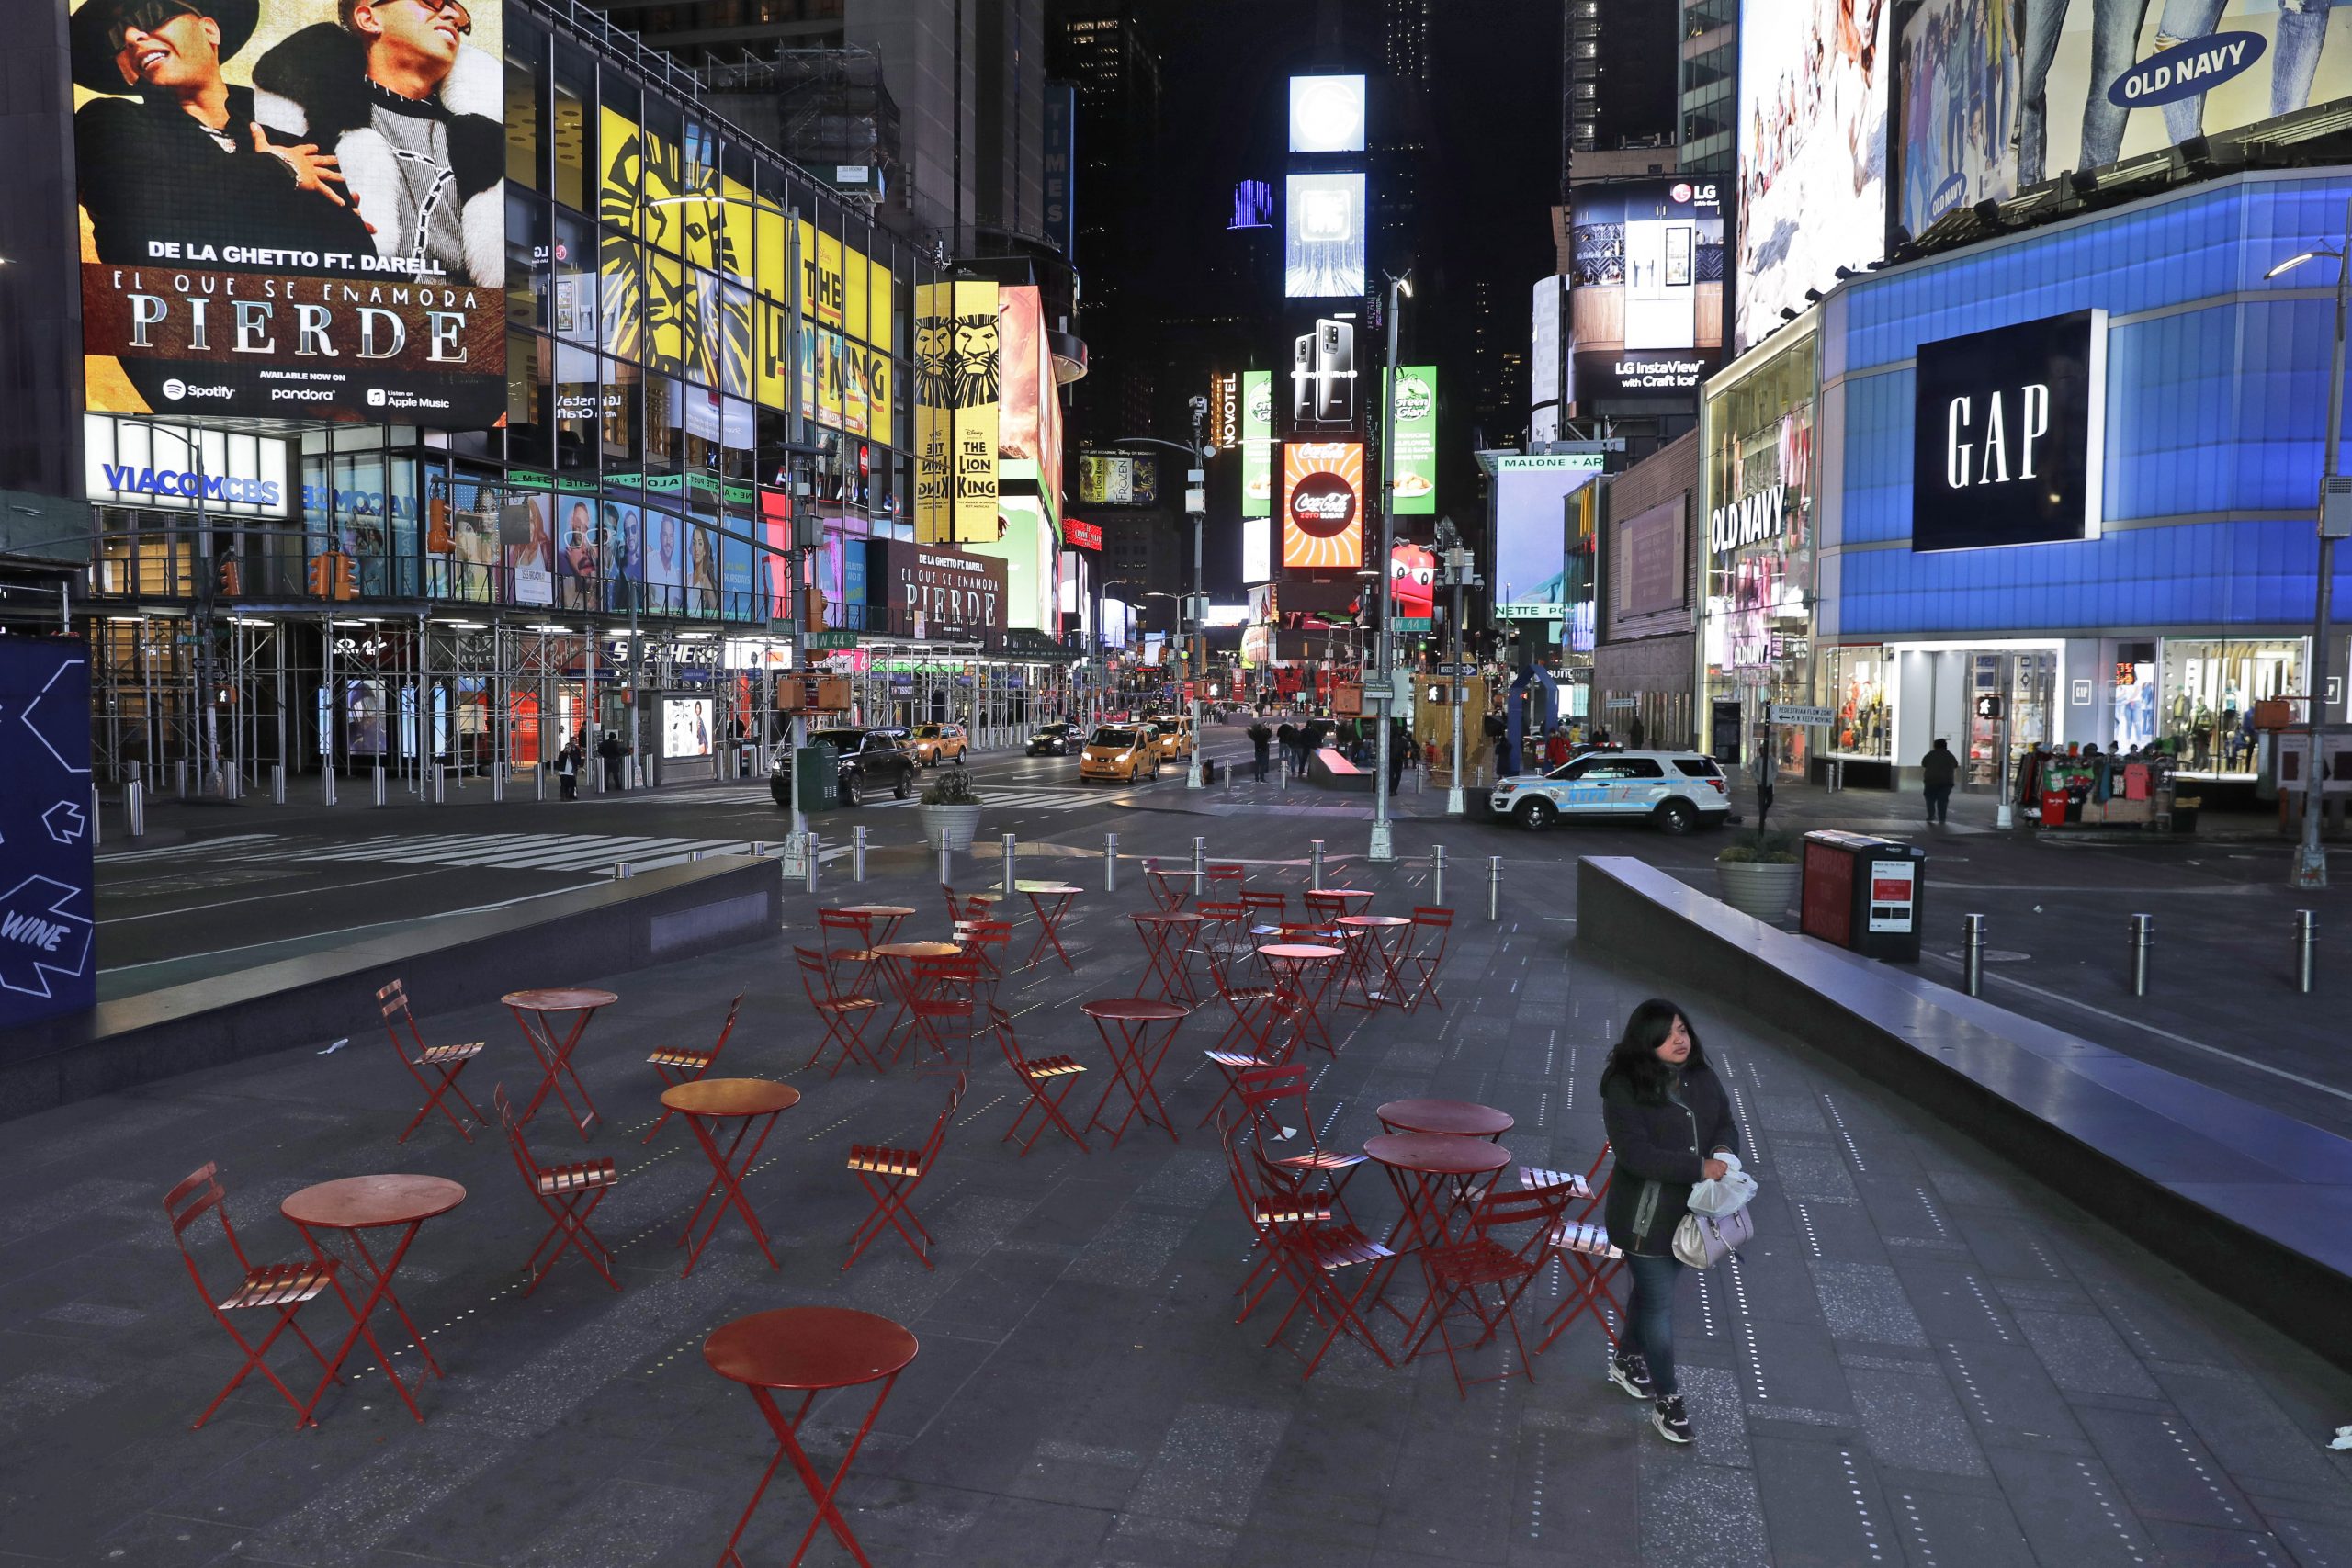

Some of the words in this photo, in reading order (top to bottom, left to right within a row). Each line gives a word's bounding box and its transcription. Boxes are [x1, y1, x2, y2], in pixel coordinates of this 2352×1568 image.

[2124, 66, 2171, 100] OLD
[2177, 39, 2246, 84] NAVY
[1694, 185, 1716, 199] LG
[1932, 194, 1945, 216] OLD
[1945, 178, 1963, 208] NAVY
[148, 241, 181, 259] DE
[187, 243, 218, 261] LA
[222, 245, 319, 268] GHETTO
[323, 253, 356, 270] FT.
[360, 254, 447, 276] DARELL
[114, 270, 143, 290] EL
[175, 274, 234, 295] QUE
[264, 279, 295, 299] SE
[323, 283, 477, 310] ENAMORA
[804, 259, 842, 309] THE
[127, 294, 468, 363] PIERDE
[260, 370, 308, 380] AVAILABLE
[310, 372, 329, 381] NOW
[331, 374, 345, 382] ON
[1615, 362, 1635, 375] LG
[1622, 378, 1642, 388] with
[1643, 375, 1675, 388] Craft
[1677, 375, 1696, 387] Ice
[188, 385, 234, 400] Spotify
[271, 389, 335, 401] pandora
[388, 397, 418, 408] Apple
[419, 398, 449, 409] Music
[1223, 372, 1236, 448] NOVOTEL
[1395, 398, 1429, 407] Green
[1396, 407, 1429, 417] Giant
[1947, 384, 2049, 489] GAP
[963, 442, 986, 453] THE
[959, 456, 991, 474] LION
[1504, 458, 1566, 467] MALONE
[103, 463, 280, 505] VIACOMCBS
[957, 476, 996, 498] KING
[1116, 460, 1129, 502] FROZEN
[1295, 492, 1351, 513] Coca-Cola
[1711, 502, 1739, 554] OLD
[1740, 483, 1787, 546] NAVY
[919, 554, 928, 565] DE
[927, 555, 935, 566] LA
[935, 556, 956, 569] GHETTO
[965, 560, 985, 573] DARELL
[724, 573, 751, 585] HURSDAYS
[901, 567, 911, 581] EL
[919, 570, 936, 584] QUE
[943, 572, 952, 586] SE
[905, 583, 996, 627] PIERDE
[1496, 606, 1539, 615] NETTE
[1396, 618, 1402, 628] W
[1407, 618, 1419, 629] 44
[819, 634, 828, 646] W
[832, 634, 845, 647] 44
[849, 633, 856, 643] St
[1735, 646, 1747, 665] OLD
[1747, 644, 1766, 664] NAVY
[2075, 686, 2087, 698] GAP
[1778, 706, 1806, 715] PEDESTRIAN
[1807, 707, 1819, 716] FLOW
[1820, 708, 1832, 716] ZONE
[0, 909, 71, 952] WINE
